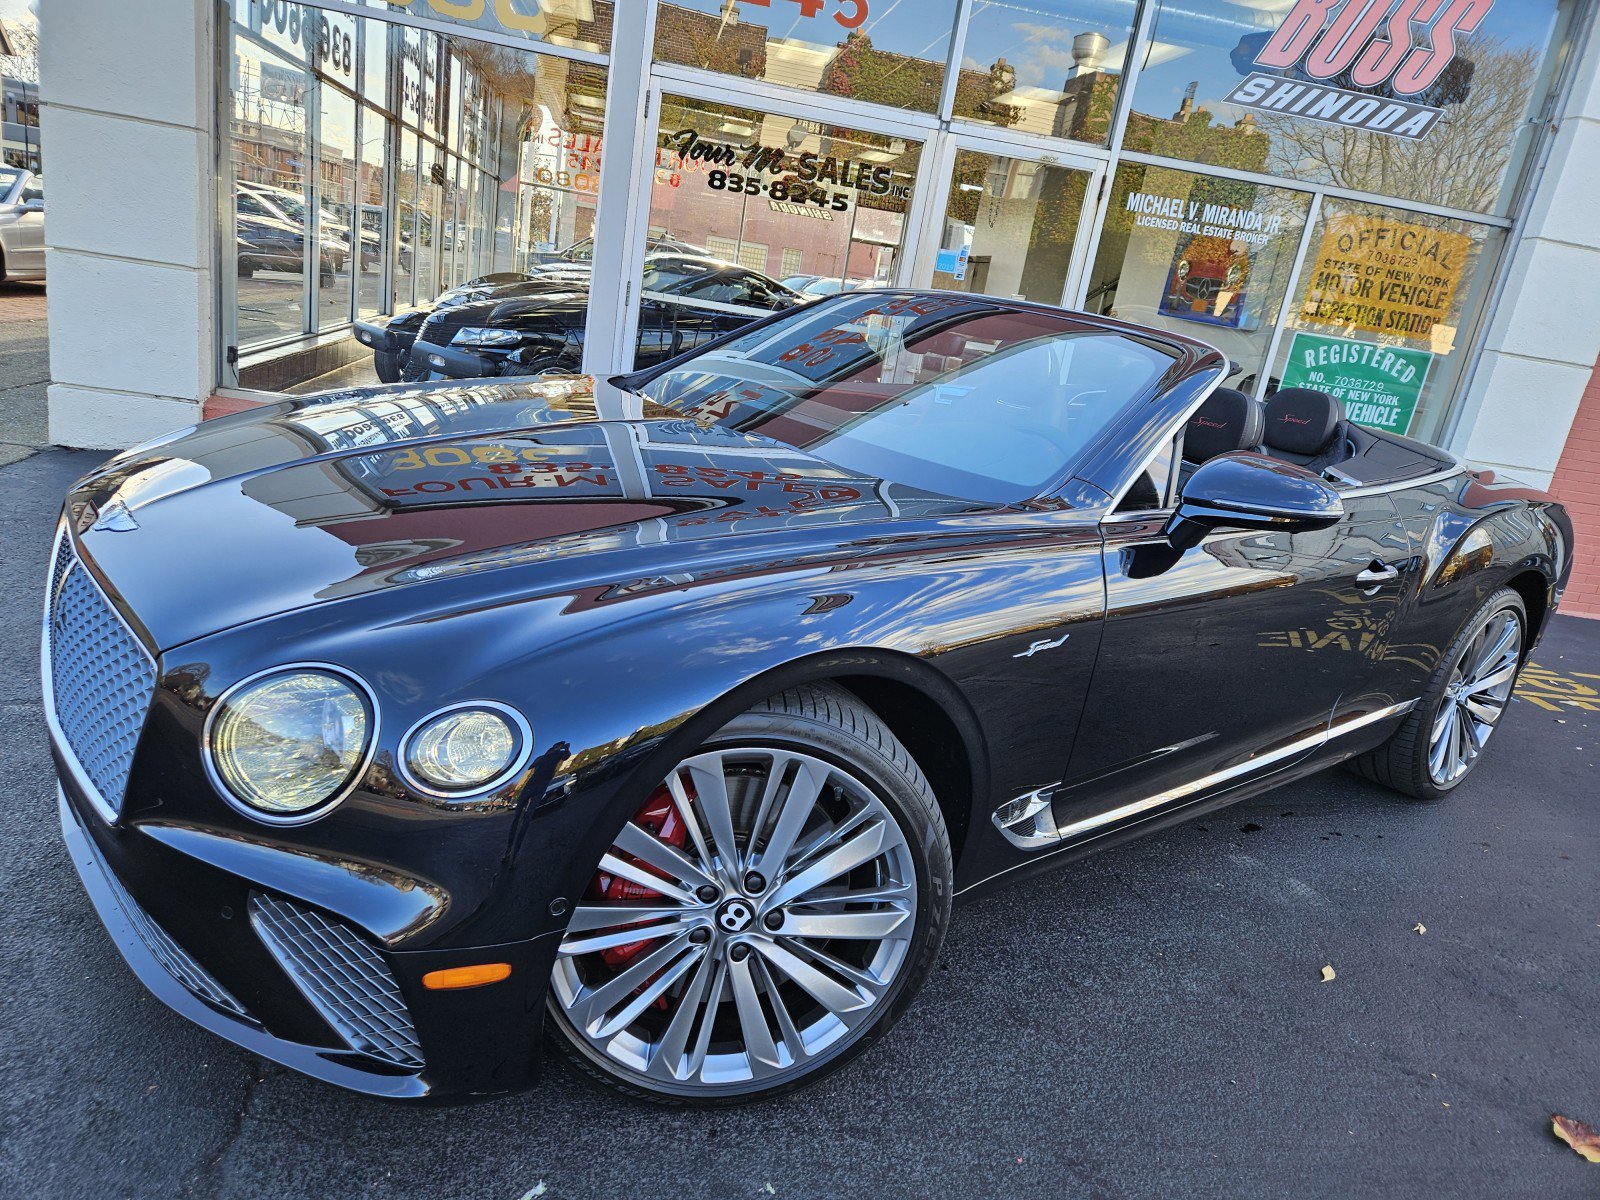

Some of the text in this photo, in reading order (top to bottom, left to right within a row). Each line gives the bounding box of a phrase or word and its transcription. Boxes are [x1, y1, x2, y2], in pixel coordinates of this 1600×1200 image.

[1253, 0, 1494, 95] BOSS
[1232, 77, 1436, 137] SHINODA
[797, 152, 893, 195] SALES
[1126, 192, 1282, 235] MICHAEL V. MIRANDA JR.
[1136, 215, 1269, 245] LICENSED REAL ESTATE BROKER
[1337, 228, 1454, 271] OFFICIAL
[1368, 250, 1419, 268] 7038729
[1323, 258, 1450, 288] STATE OF NEW YORK
[1316, 271, 1448, 310] MOTOR VEHICLE
[1304, 343, 1416, 384] REGISTERED
[1309, 371, 1385, 391] NO. 7038729
[1332, 388, 1345, 399] OF
[1348, 390, 1372, 402] NEW
[1373, 393, 1400, 406] YORK
[1190, 416, 1228, 430] Speed
[1277, 413, 1312, 425] Speed
[1345, 402, 1401, 427] VEHICLE
